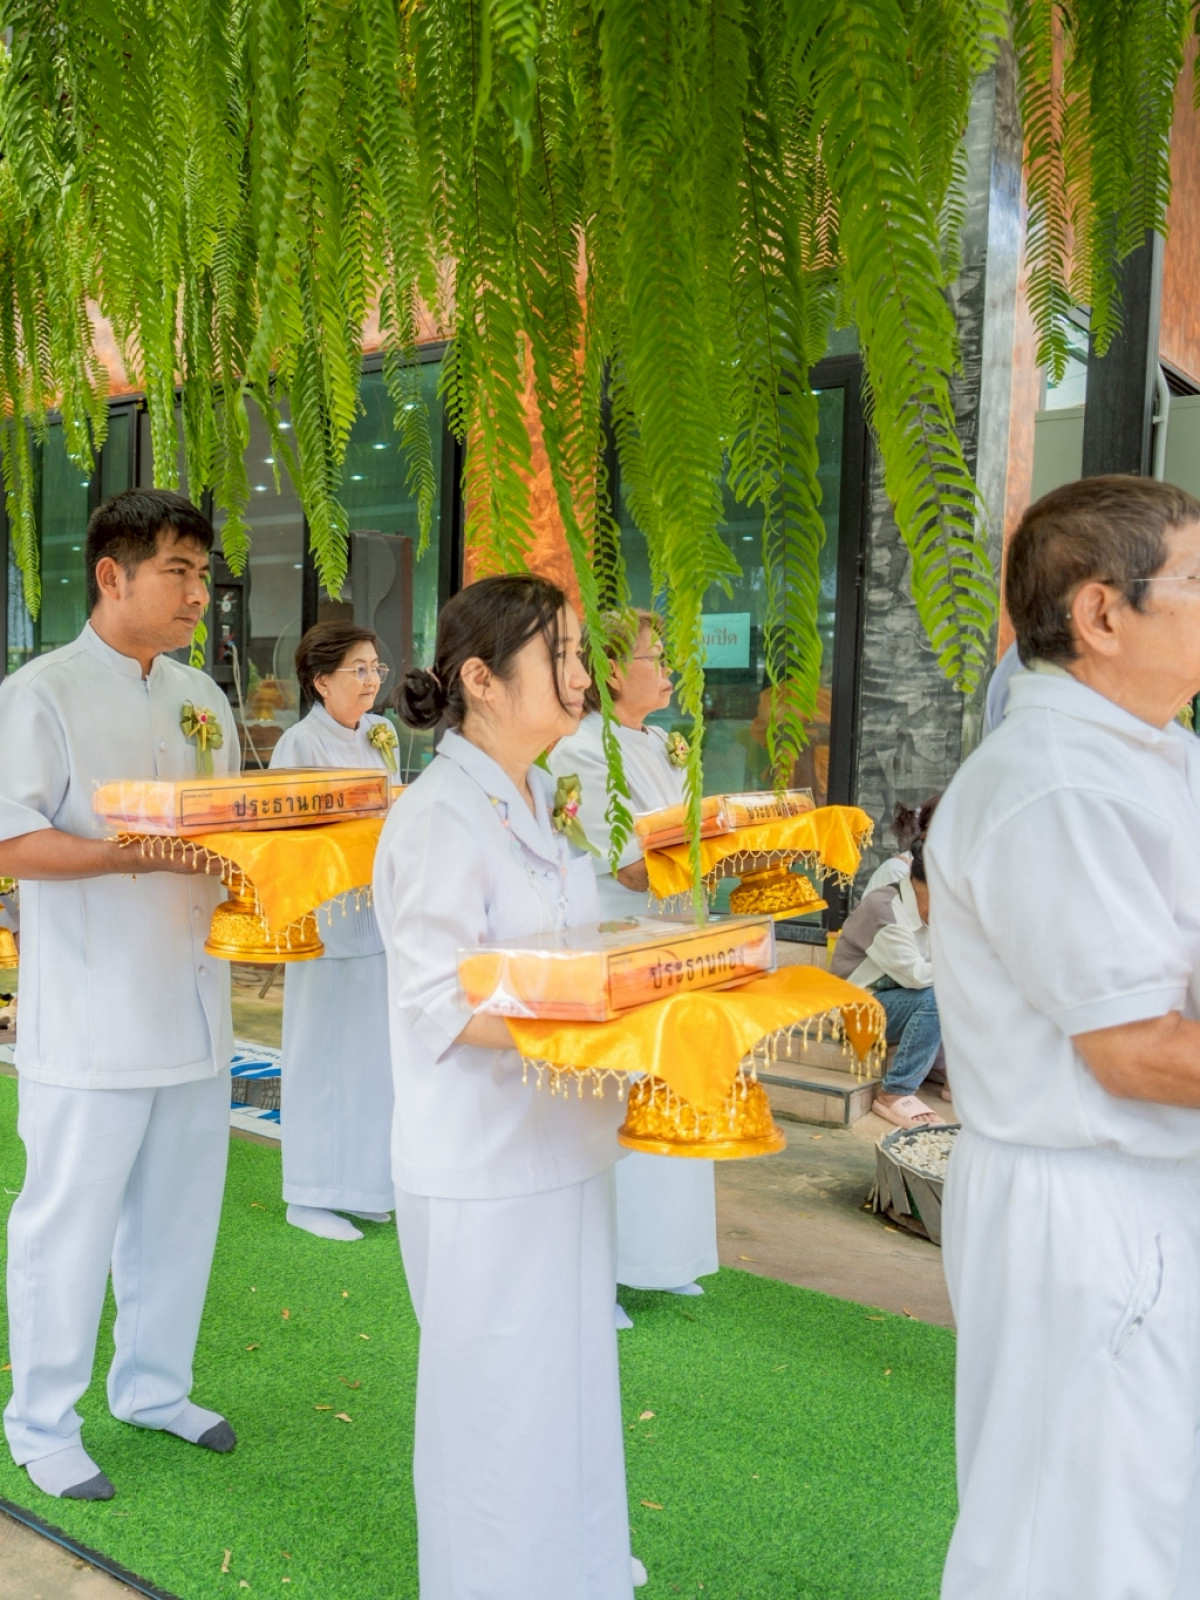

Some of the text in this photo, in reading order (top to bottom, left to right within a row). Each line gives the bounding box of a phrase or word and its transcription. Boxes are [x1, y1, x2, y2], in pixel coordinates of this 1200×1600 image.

[234, 792, 344, 817] ประธานกอง
[649, 944, 745, 989] ประธานกอง
